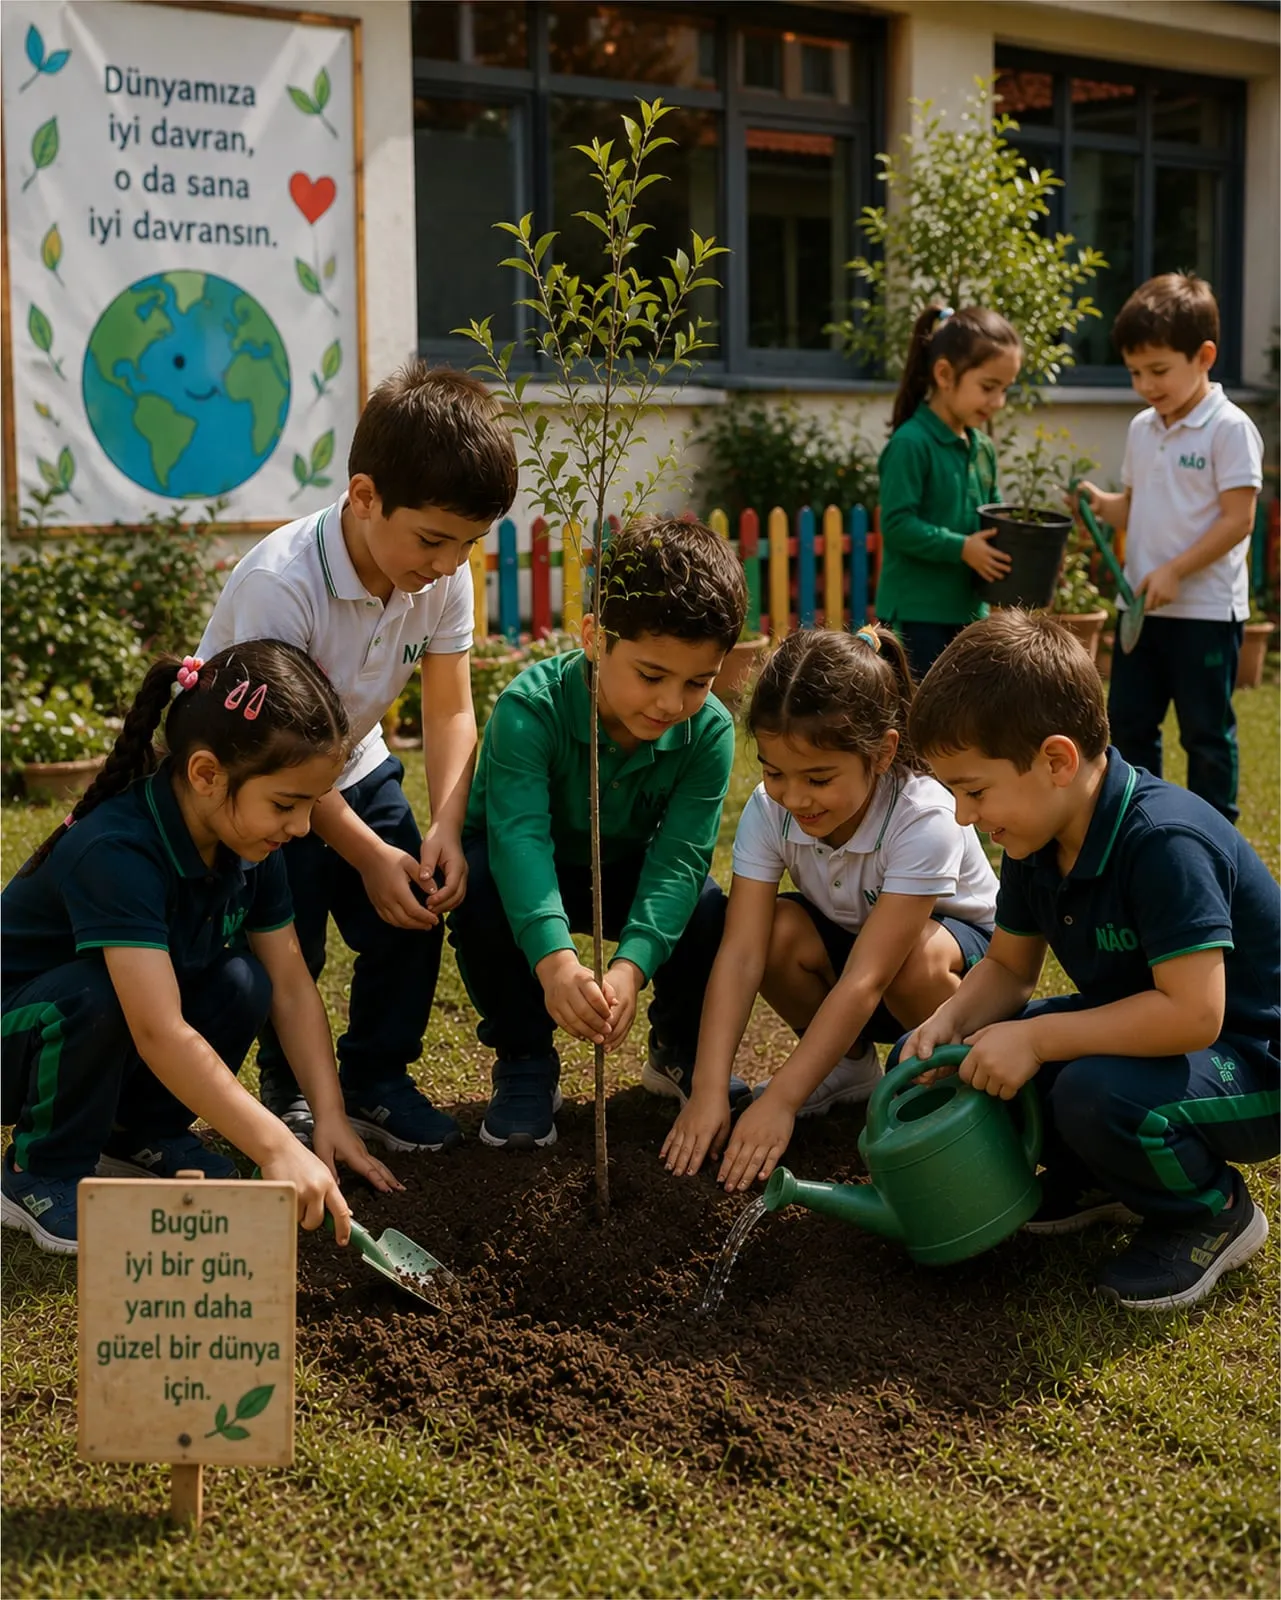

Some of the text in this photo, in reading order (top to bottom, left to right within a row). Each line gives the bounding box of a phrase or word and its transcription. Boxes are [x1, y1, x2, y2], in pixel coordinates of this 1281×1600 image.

[104, 65, 256, 107] Dünyamıza
[109, 113, 255, 158] iyi davran,
[114, 163, 250, 199] o da sana
[88, 206, 278, 248] iyi davransın.
[151, 1208, 229, 1241] Bugün
[125, 1250, 254, 1284] iyi bir gün,
[125, 1294, 252, 1324] yarın daha
[97, 1333, 280, 1366] güzel bir dünya
[164, 1376, 211, 1406] için.
